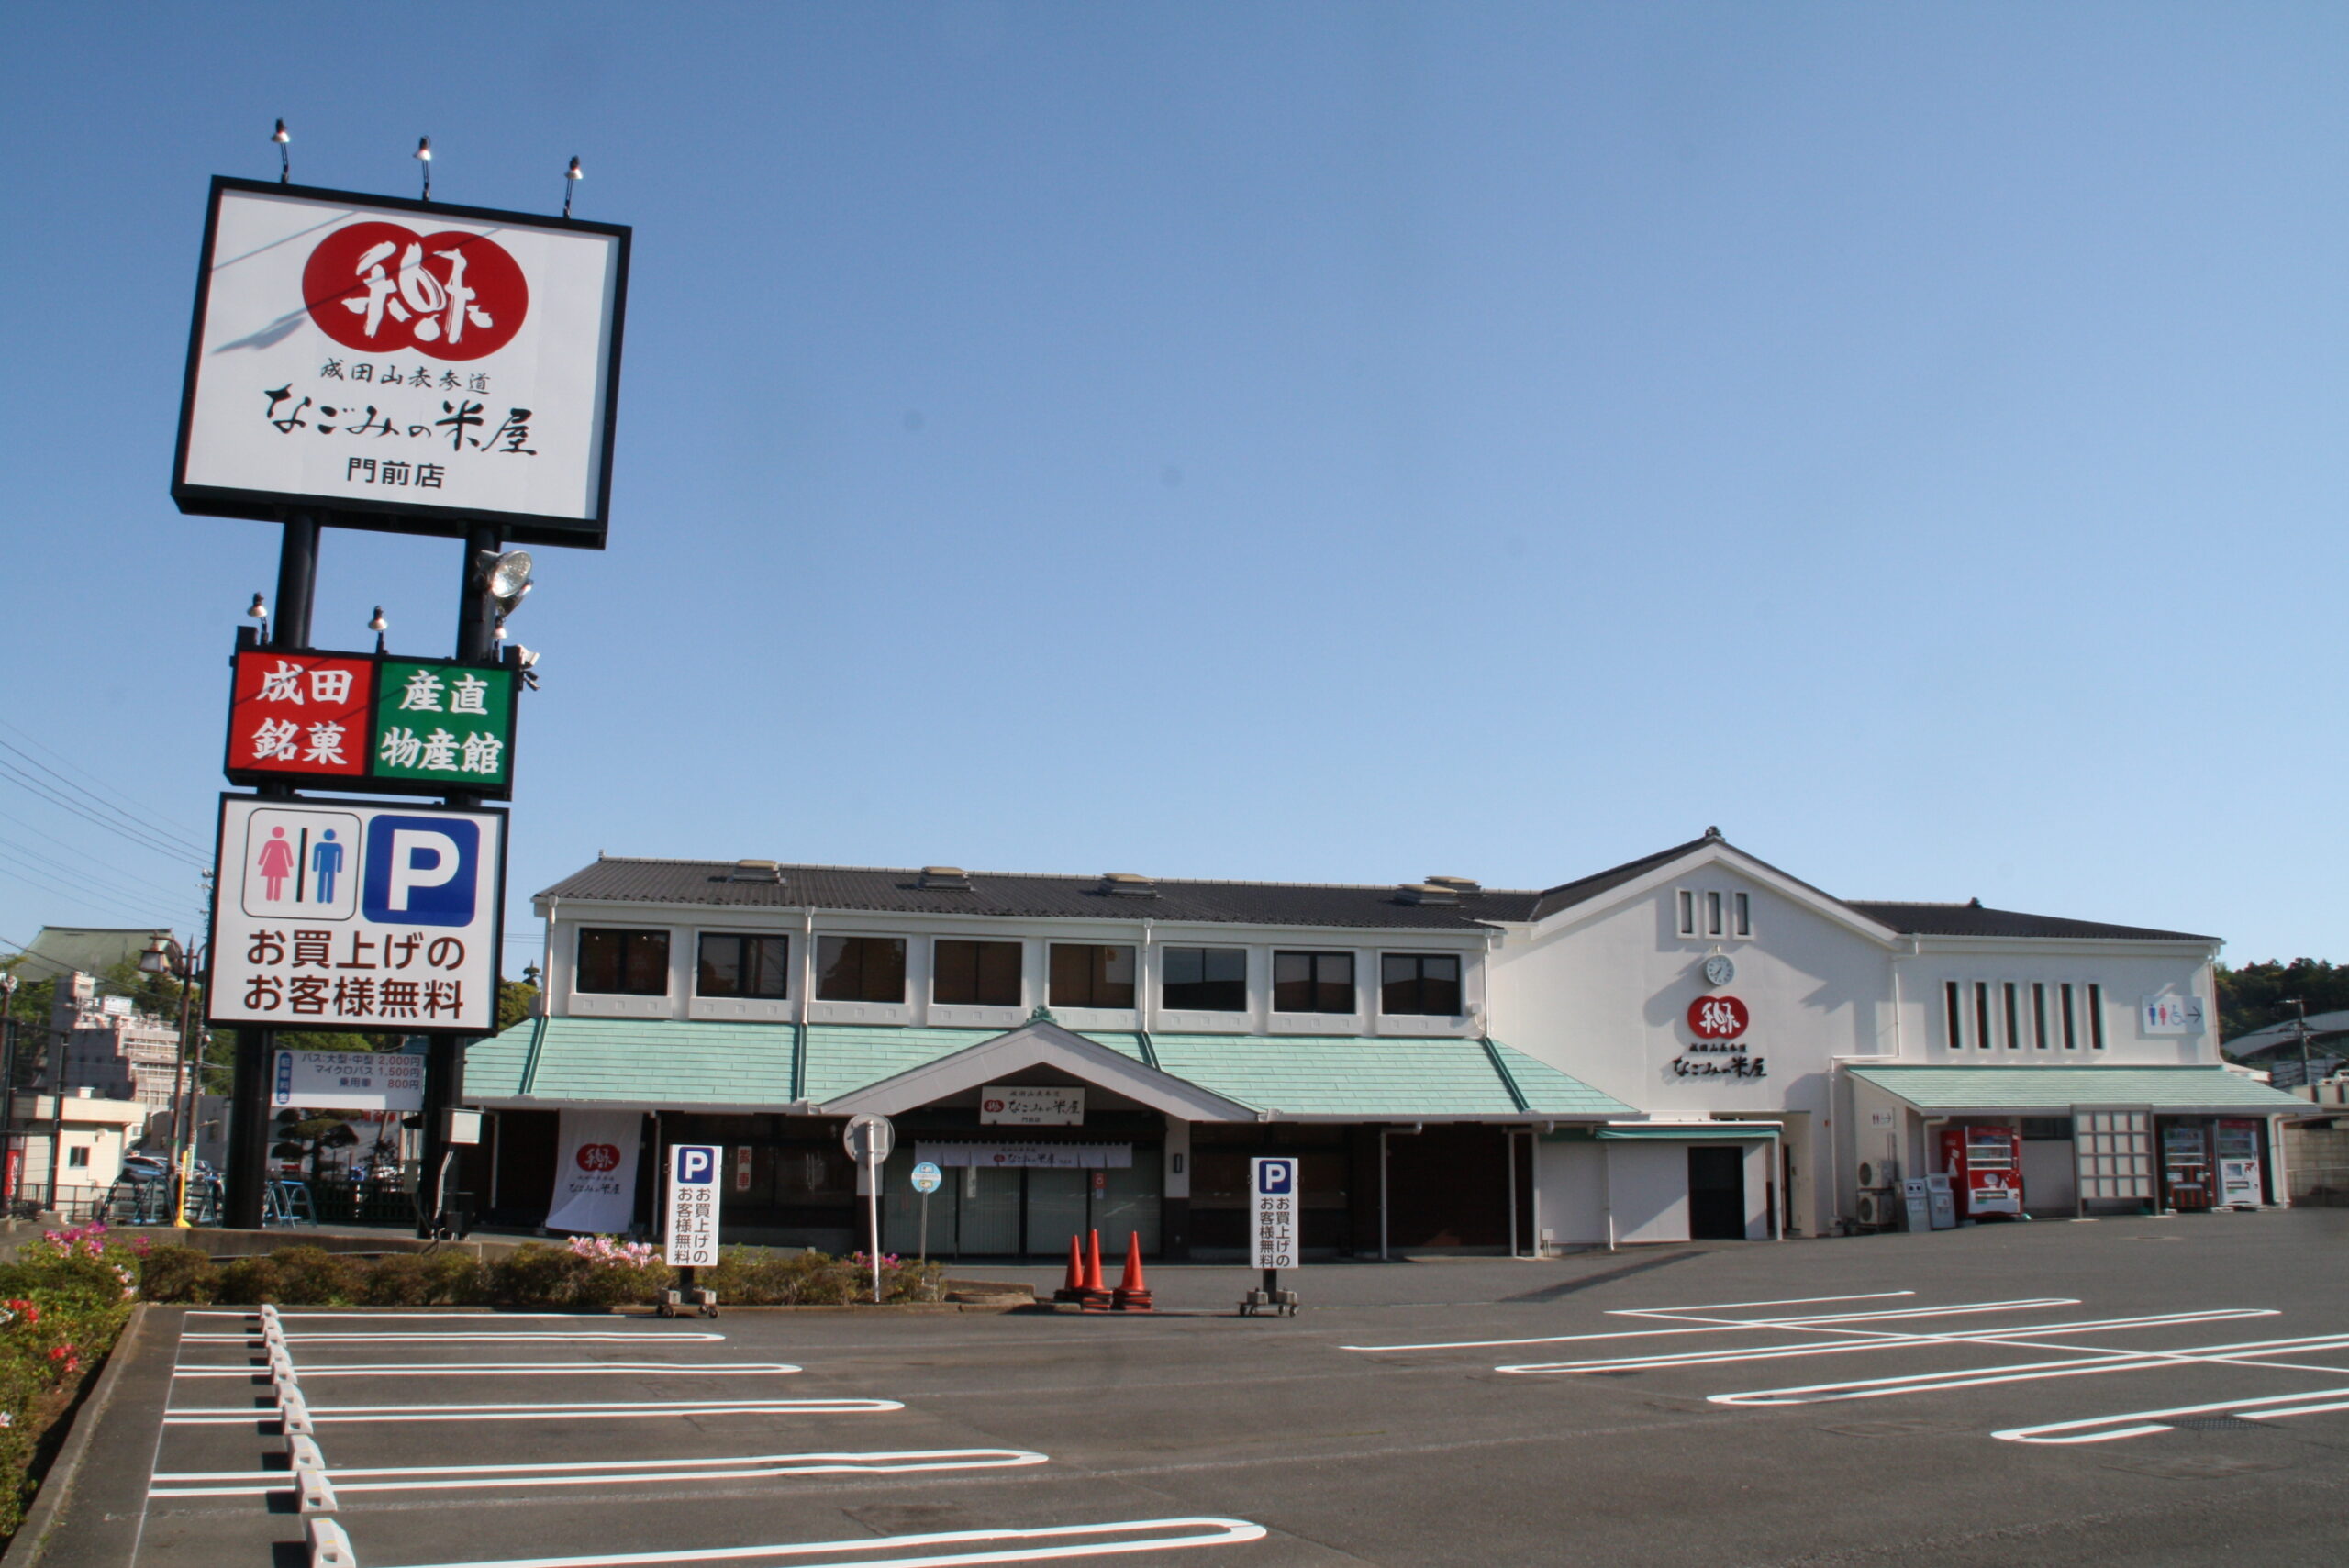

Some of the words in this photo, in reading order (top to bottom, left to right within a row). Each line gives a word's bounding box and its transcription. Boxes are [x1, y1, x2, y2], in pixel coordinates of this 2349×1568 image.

[320, 358, 492, 395] 成田山表参道
[263, 383, 538, 456] なごみの米屋
[347, 457, 446, 489] 門前店
[256, 660, 353, 705] 成田
[399, 670, 489, 715] 産直
[251, 717, 348, 765] 銘菓
[381, 727, 504, 774] 物産館
[388, 828, 460, 911] P
[247, 929, 465, 970] お買上げの
[243, 974, 463, 1019] お客様無料
[315, 1064, 373, 1075] マイクロバス
[378, 1067, 420, 1077] 1,500円
[378, 1056, 420, 1066] 2,000円
[387, 1079, 419, 1089] 800円
[685, 1151, 708, 1180] P
[1266, 1163, 1286, 1190] P
[674, 1187, 693, 1264] お客様無料
[693, 1188, 711, 1263] お買上げの
[1259, 1197, 1274, 1268] お客様無料
[1276, 1197, 1291, 1267] お買上げの
